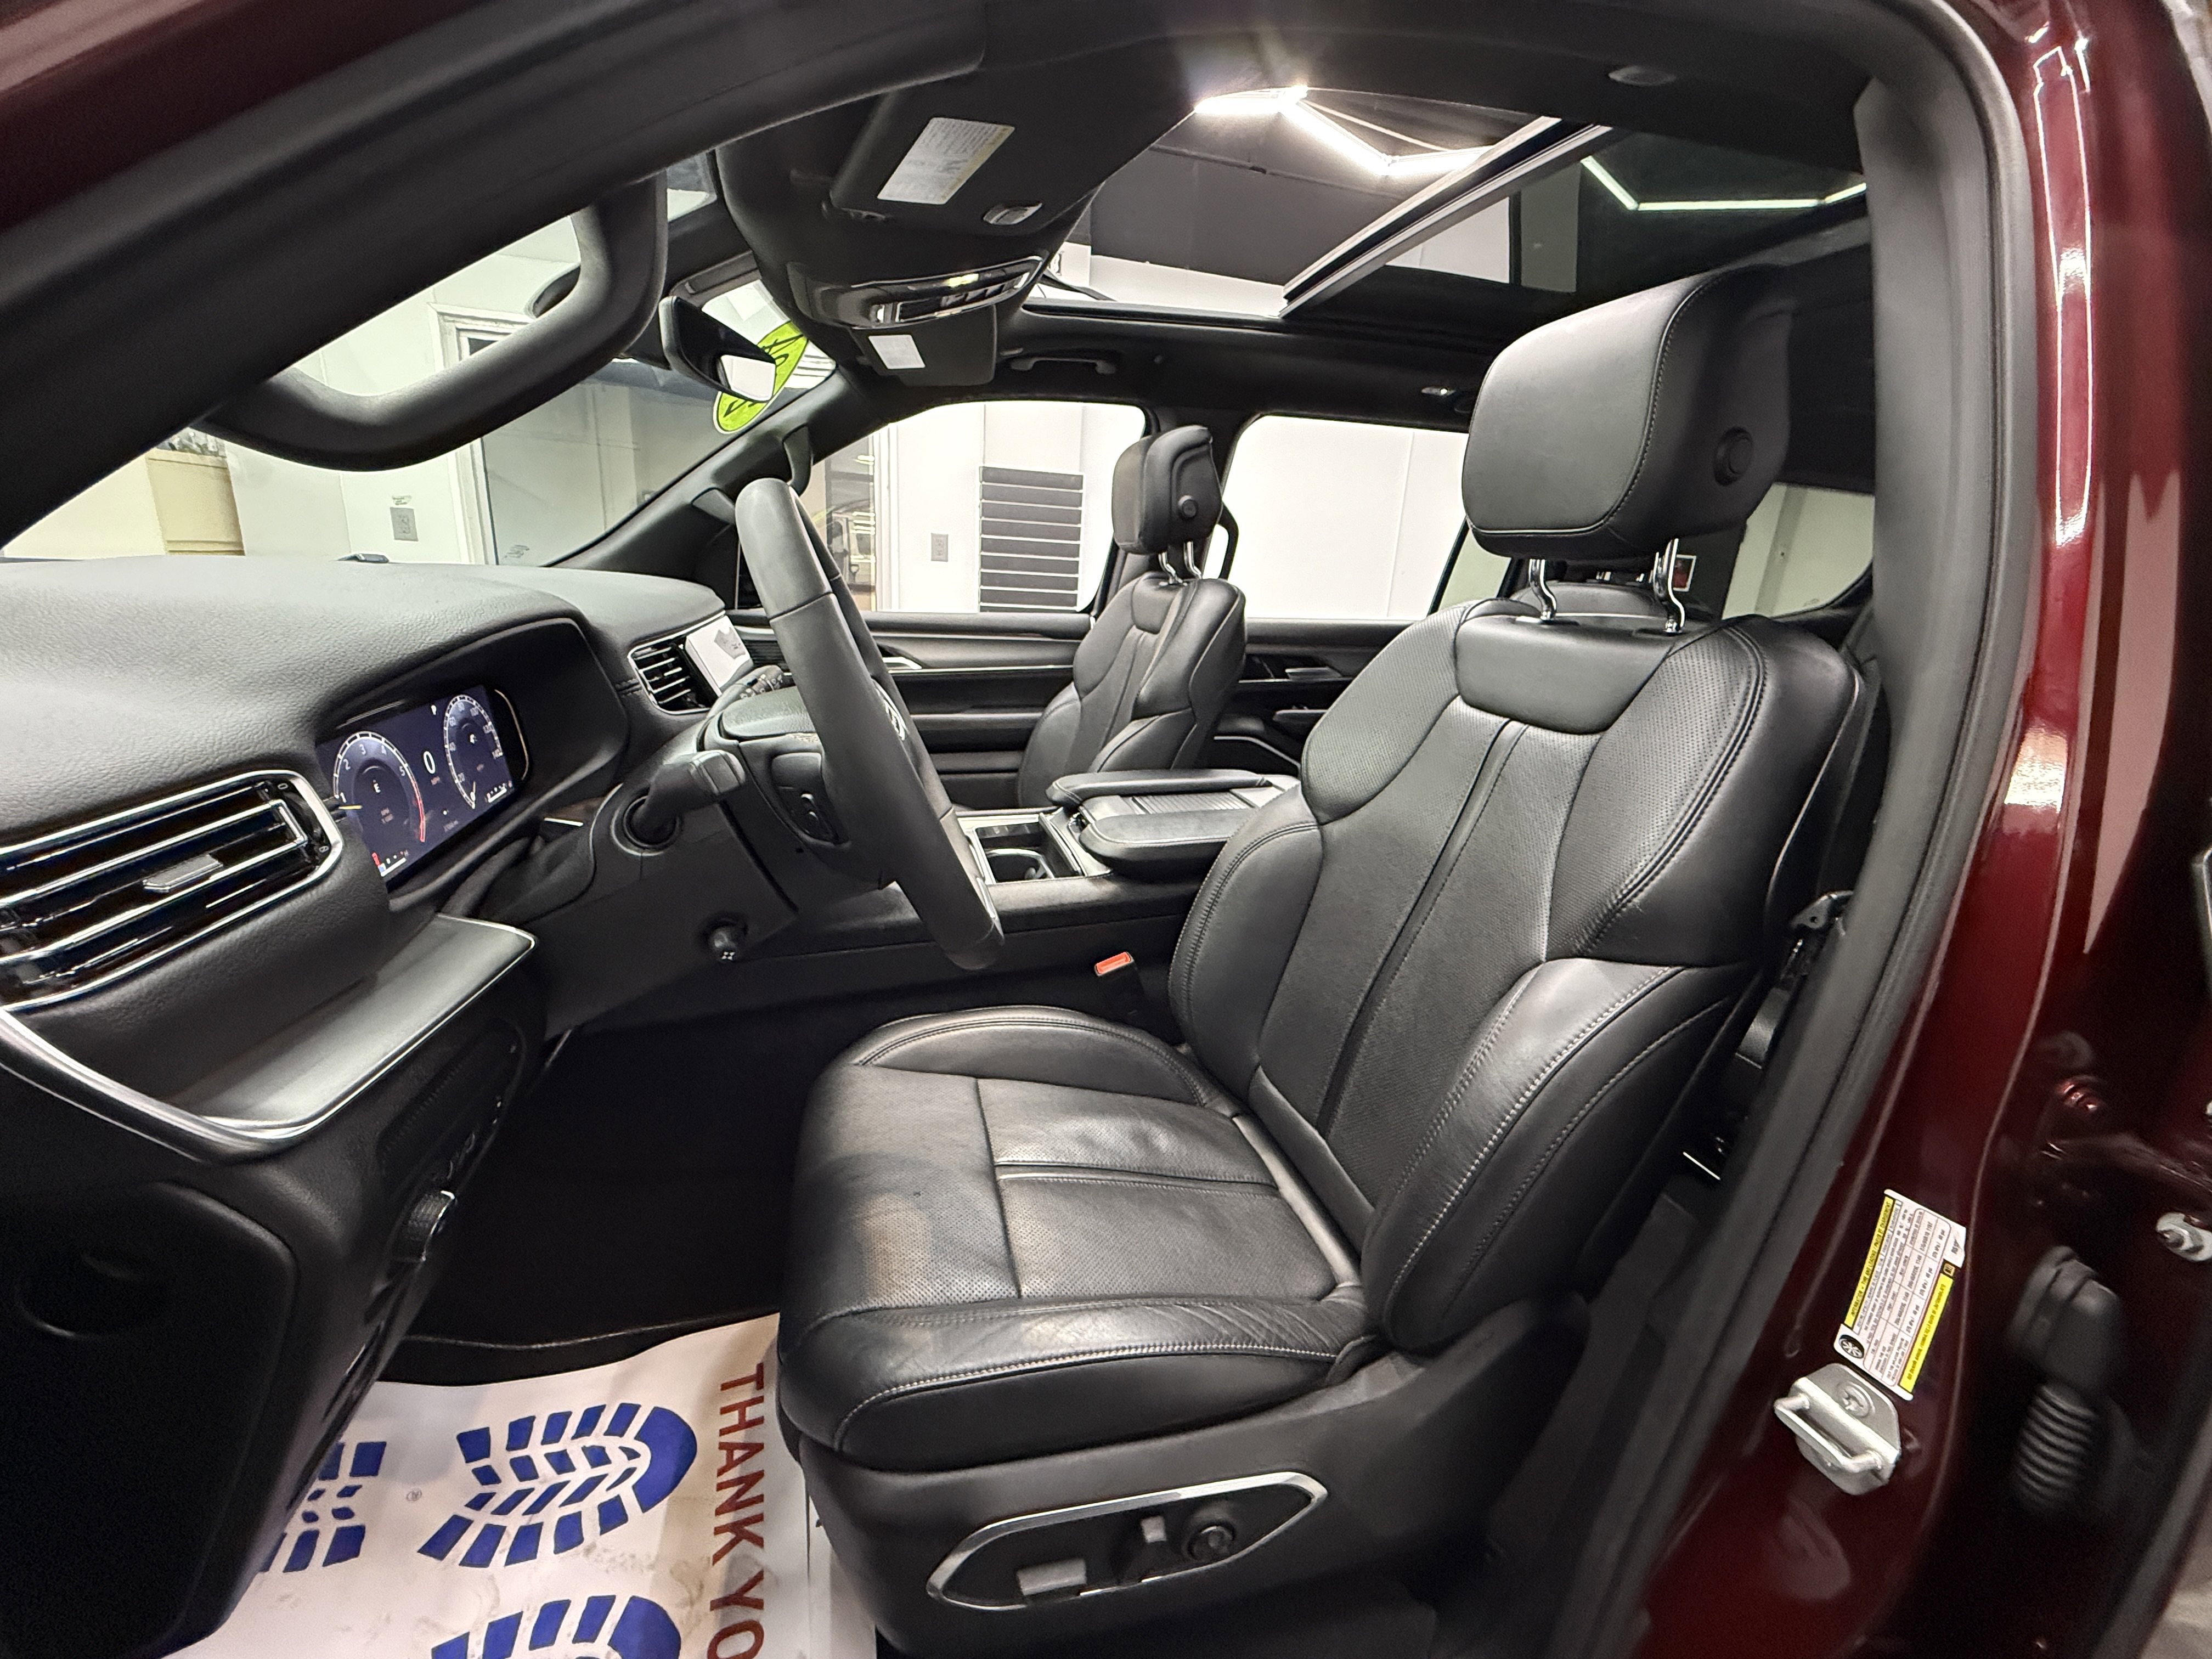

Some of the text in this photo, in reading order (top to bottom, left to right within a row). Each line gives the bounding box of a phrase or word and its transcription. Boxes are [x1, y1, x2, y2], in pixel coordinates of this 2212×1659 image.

[359, 744, 366, 755] 3
[381, 746, 387, 755] 4
[343, 759, 351, 770] 2
[423, 751, 436, 774] 0
[399, 766, 406, 776] 5
[340, 792, 346, 803] 1
[712, 1363, 765, 1566] THANK
